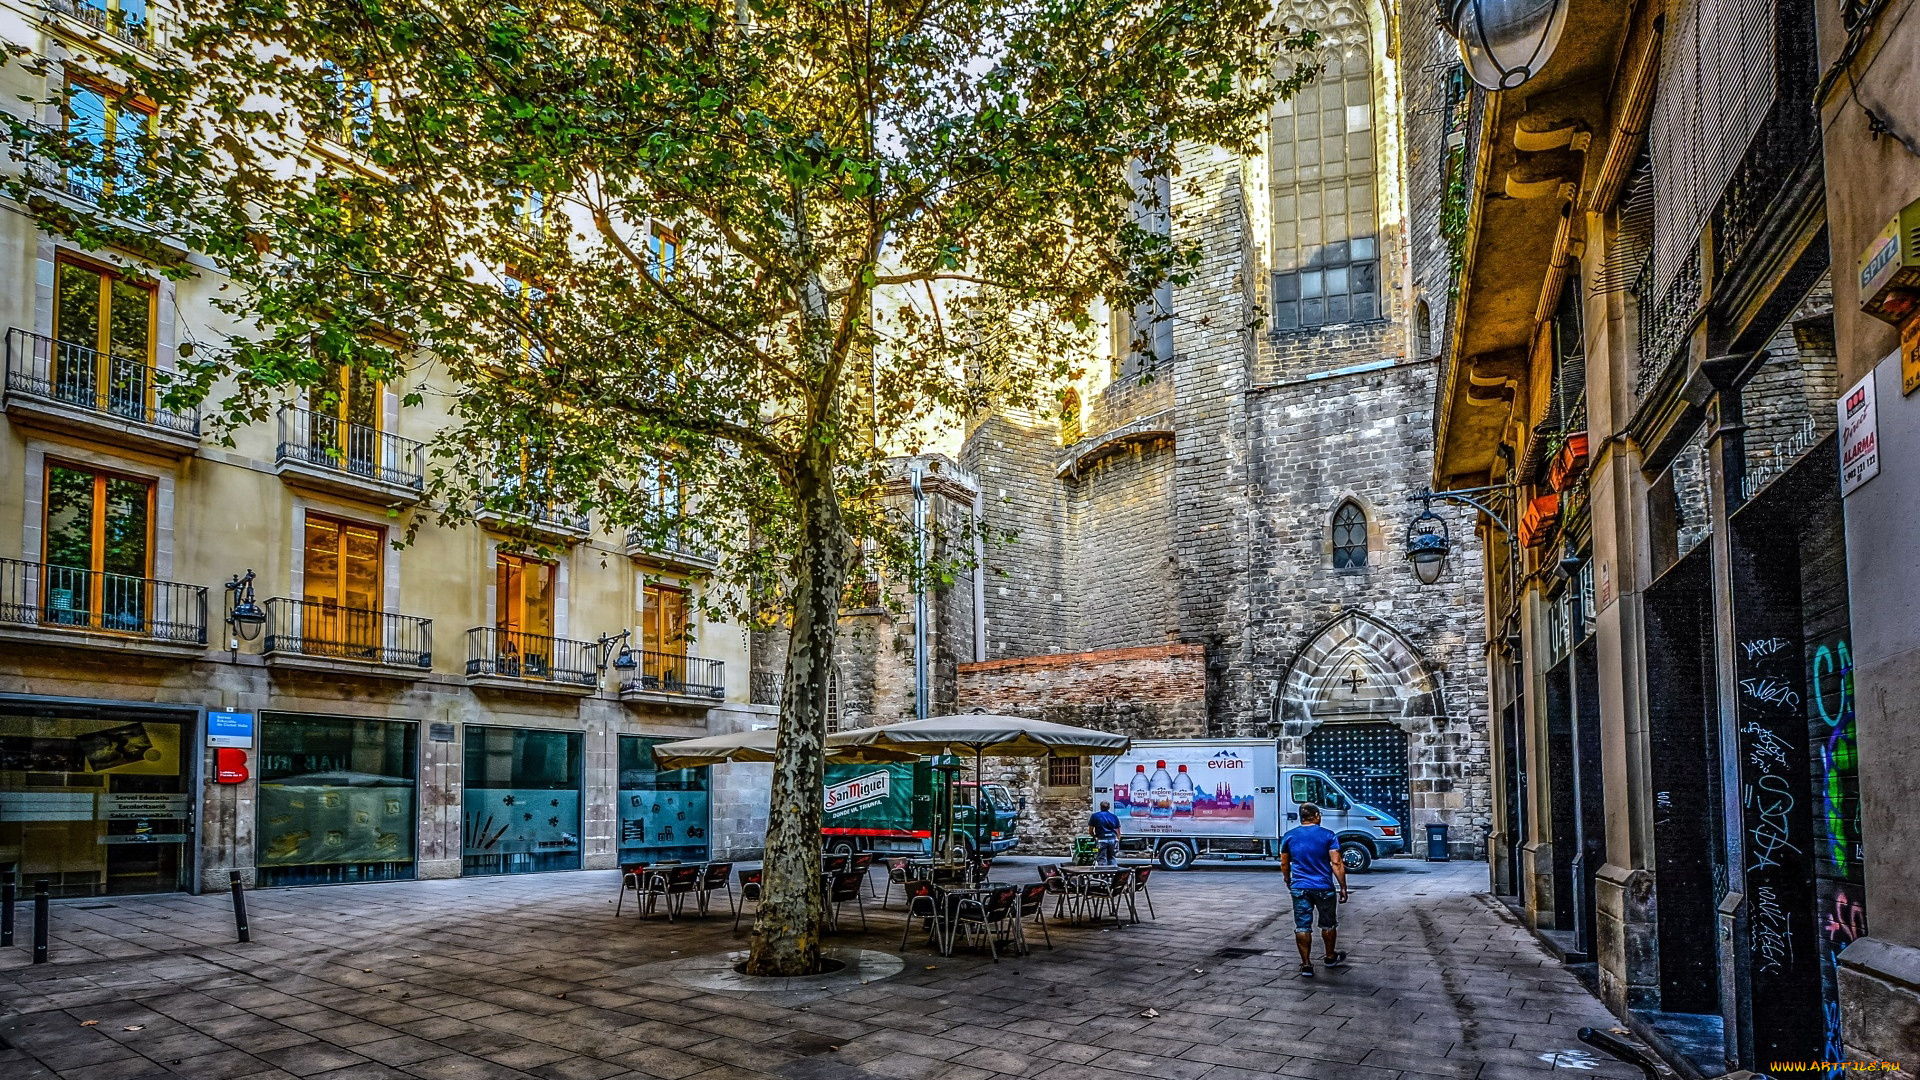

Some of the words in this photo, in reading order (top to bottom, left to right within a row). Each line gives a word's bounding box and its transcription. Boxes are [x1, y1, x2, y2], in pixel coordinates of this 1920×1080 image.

[1862, 237, 1898, 285] SPITZ
[1843, 432, 1874, 466] ALARMA
[1741, 459, 1771, 499] tapes
[1207, 758, 1244, 769] evian
[832, 808, 850, 819] DONDE
